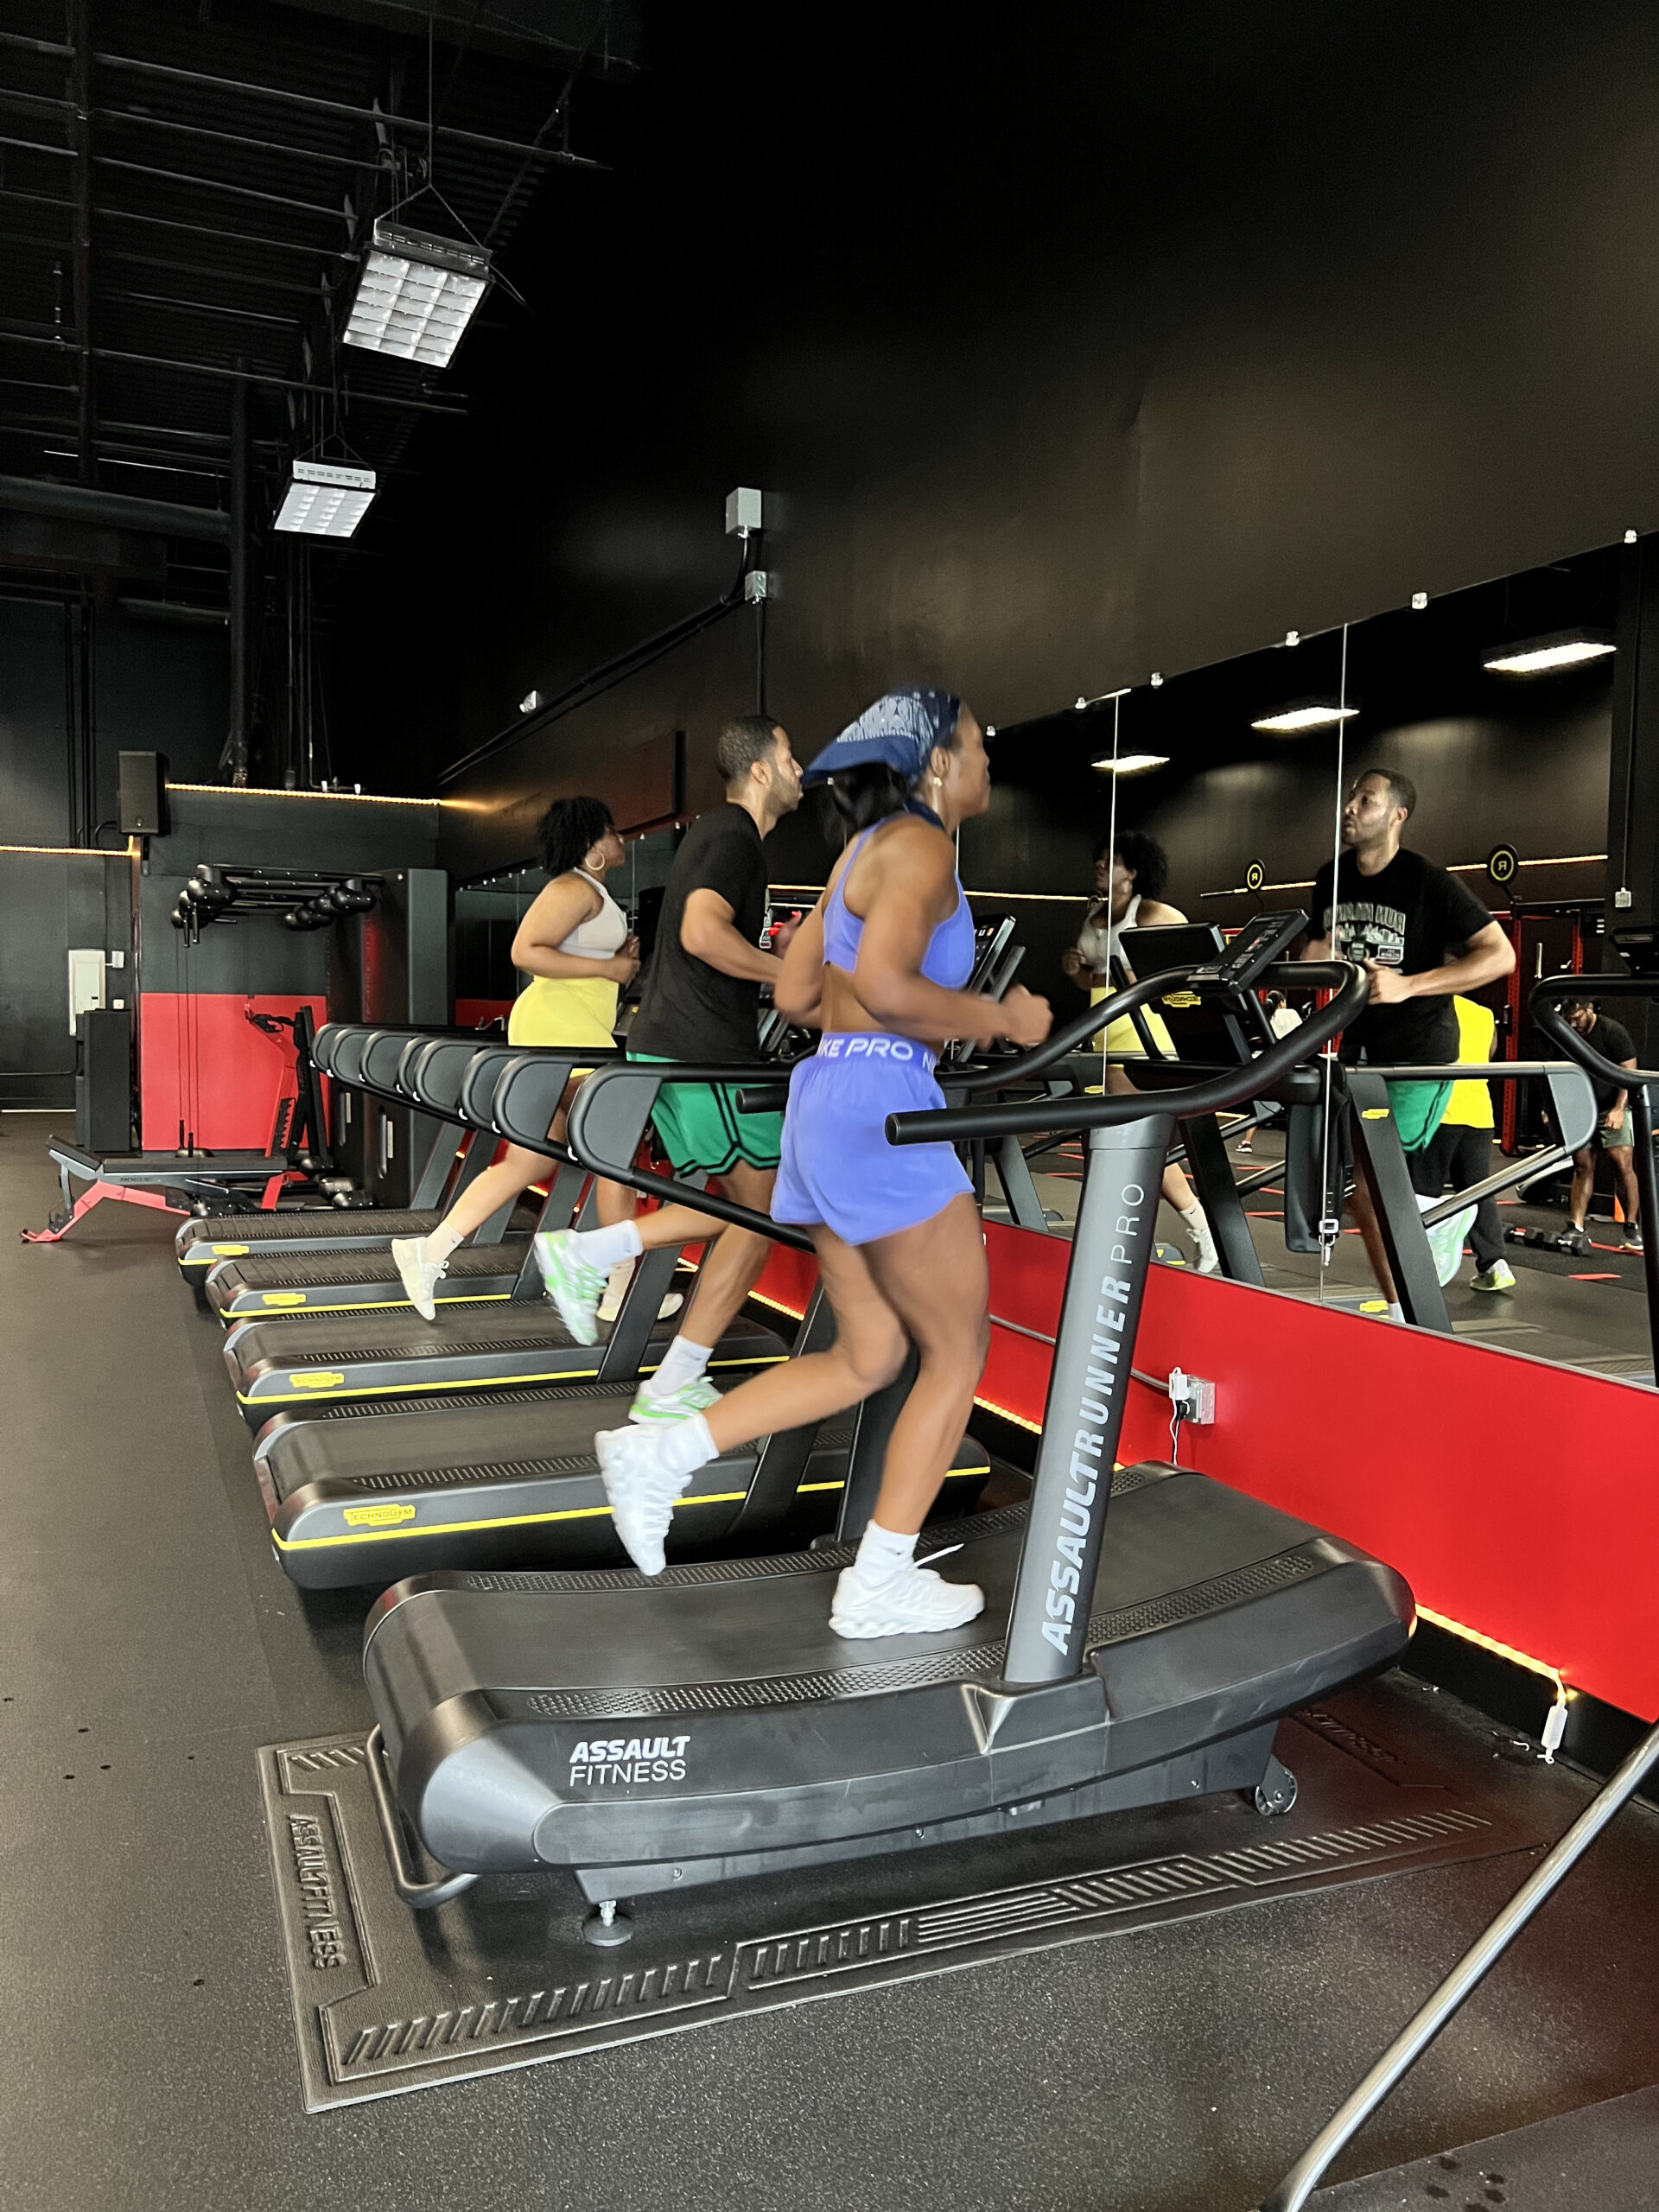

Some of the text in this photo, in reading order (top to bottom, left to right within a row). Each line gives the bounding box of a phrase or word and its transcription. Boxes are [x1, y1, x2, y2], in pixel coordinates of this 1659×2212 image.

[845, 1038, 914, 1061] PRO
[1110, 1183, 1145, 1264] PRO
[346, 1508, 413, 1522] TECHNOGYM
[569, 1735, 691, 1764] ASSAULT
[569, 1759, 687, 1788] FITNESS
